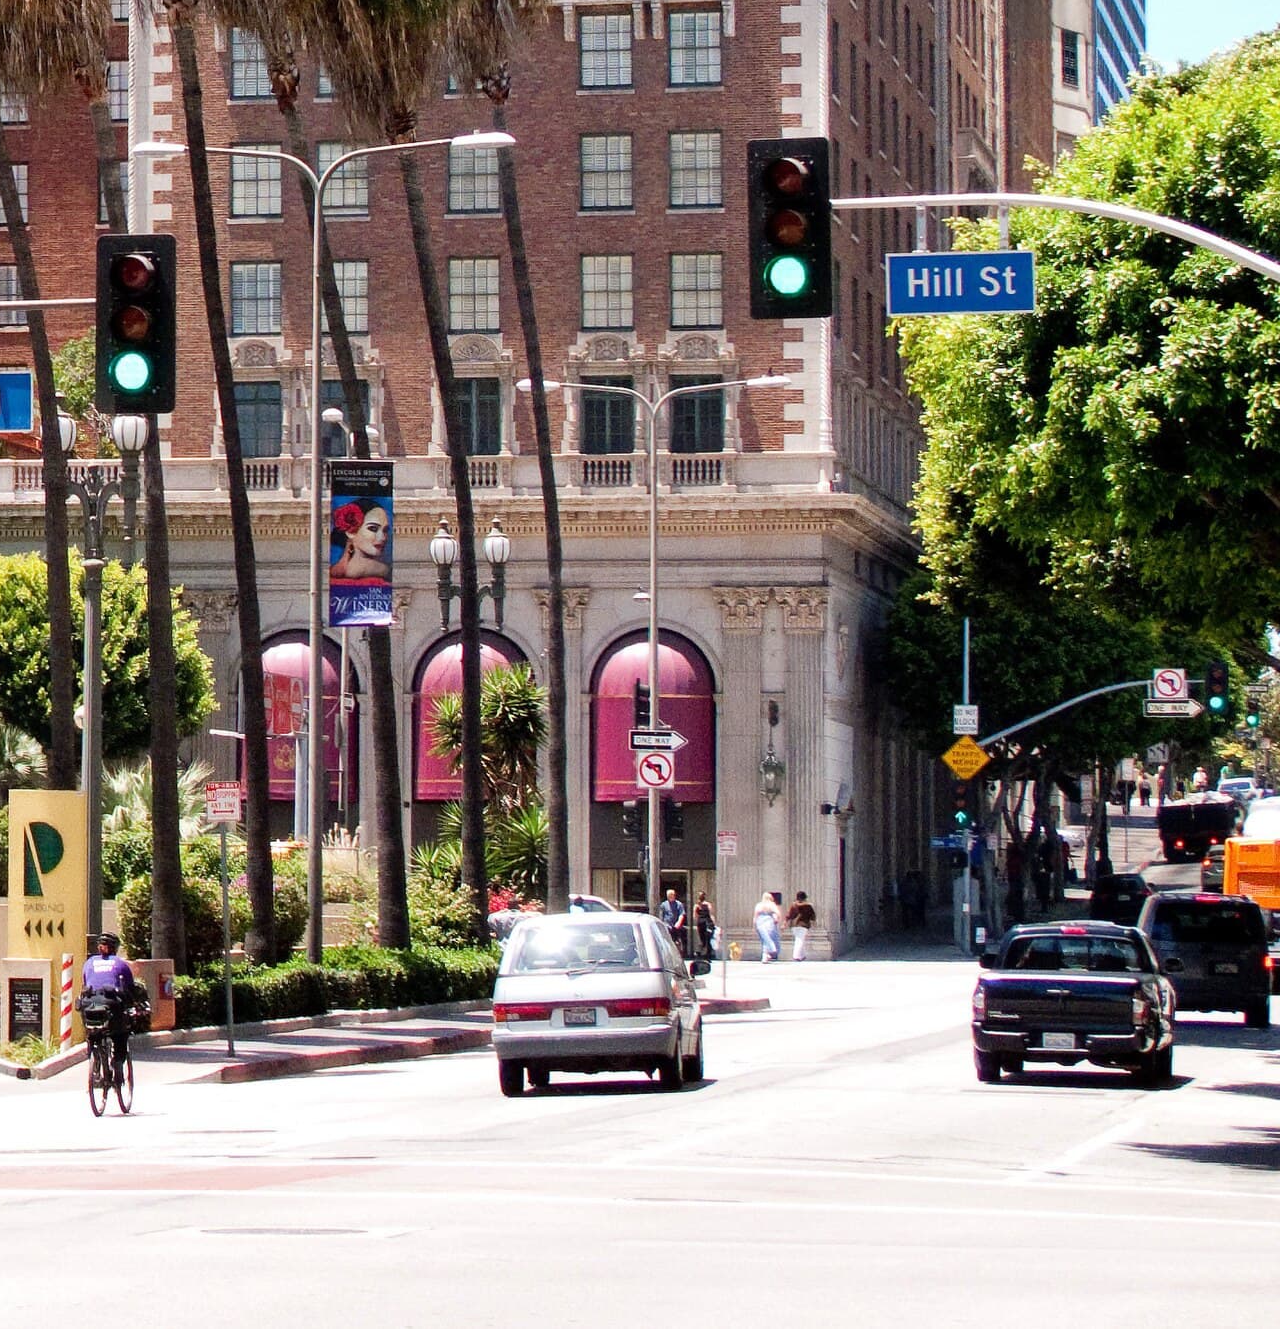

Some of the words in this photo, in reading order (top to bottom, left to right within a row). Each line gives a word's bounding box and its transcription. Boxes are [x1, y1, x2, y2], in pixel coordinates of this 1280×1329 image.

[907, 267, 963, 297] Hill
[979, 266, 1016, 296] St
[635, 736, 652, 744] ONE
[23, 822, 65, 897] P
